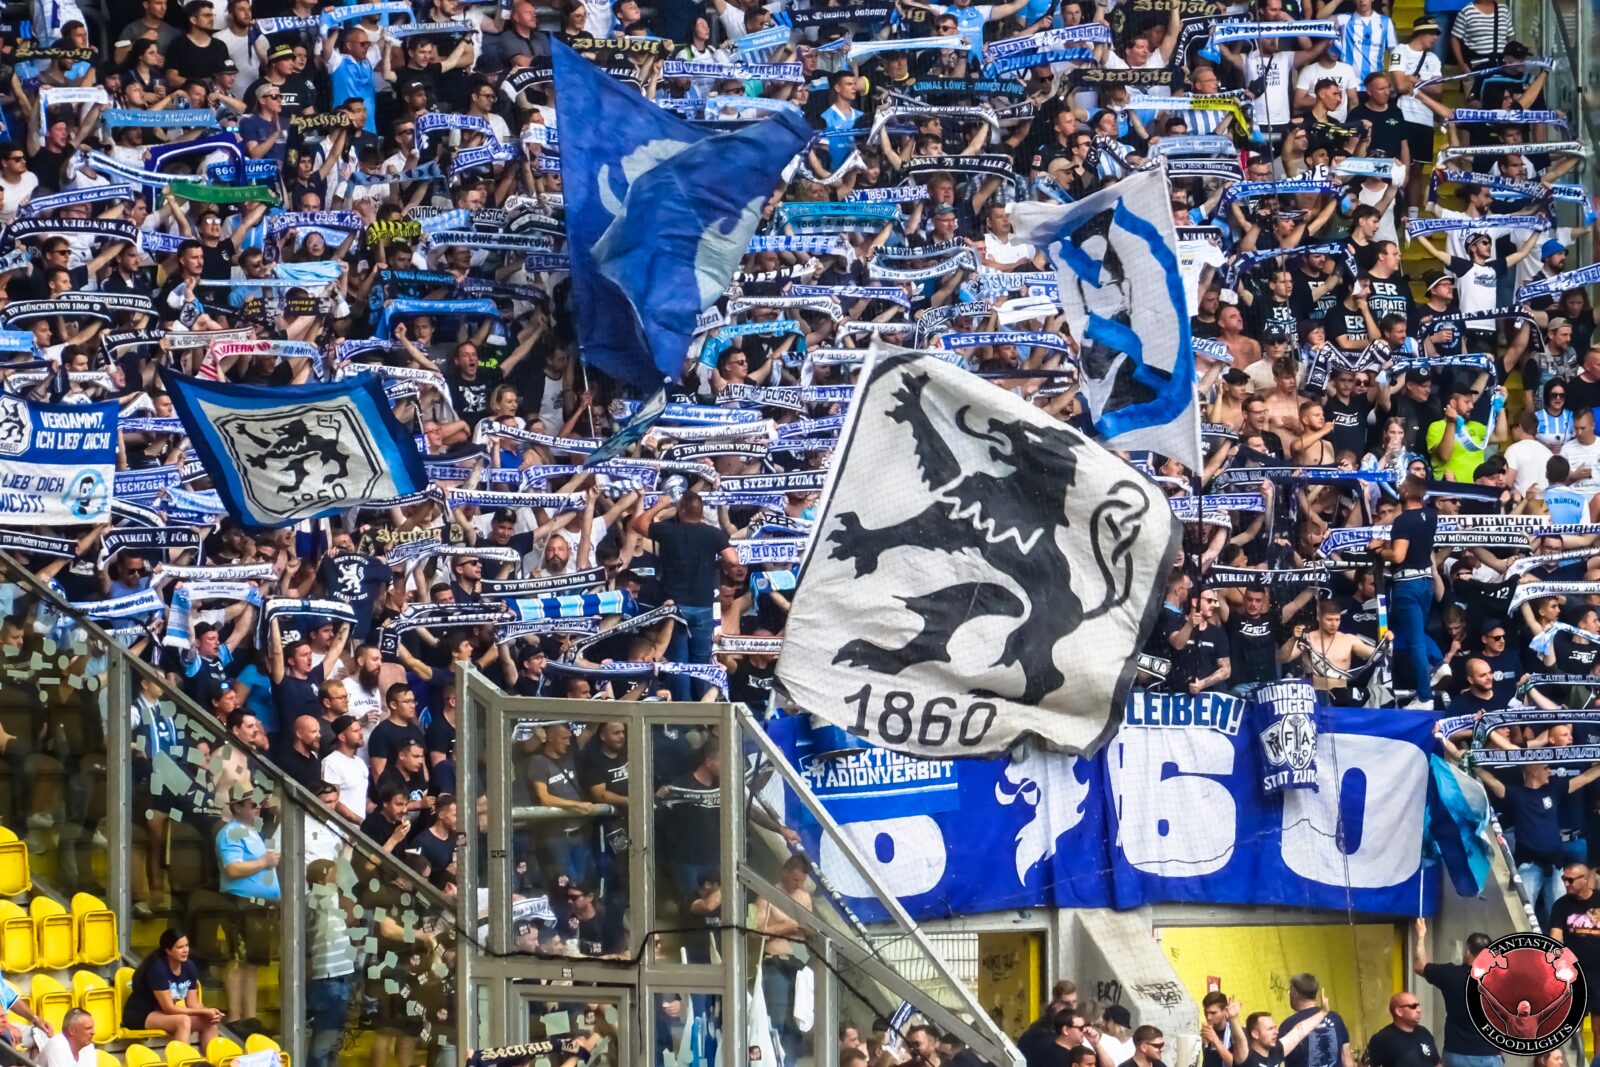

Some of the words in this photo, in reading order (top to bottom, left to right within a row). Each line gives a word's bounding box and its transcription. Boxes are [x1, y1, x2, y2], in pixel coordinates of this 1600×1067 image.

[1219, 25, 1239, 36] TSV
[607, 65, 629, 77] ALLE
[683, 62, 724, 73] VEREIN
[513, 73, 535, 85] MEIN
[1082, 69, 1173, 83] Sechzig
[913, 81, 943, 92] EINMAL
[944, 80, 967, 90] LÖWE
[1001, 83, 1025, 95] LÖWE
[1471, 172, 1495, 183] 1860
[1499, 175, 1549, 197] MÜNCHEN
[10, 219, 35, 233] 1860
[37, 219, 59, 229] VON
[63, 219, 117, 230] MÜNCHEN
[119, 221, 137, 236] TSV
[431, 232, 466, 244] EINMAL
[466, 233, 492, 244] LÖWE
[1373, 282, 1397, 295] ER
[6, 305, 18, 316] TSV
[18, 302, 54, 313] MÜNCHEN
[54, 302, 71, 311] VON
[71, 302, 90, 311] 1860
[118, 296, 134, 306] VON
[134, 297, 152, 310] 1860
[1369, 299, 1407, 313] HEIRATET
[1272, 306, 1292, 319] ER
[1484, 306, 1510, 318] VON
[1345, 314, 1365, 328] ER
[950, 334, 977, 346] DES
[979, 333, 993, 343] IS
[994, 331, 1065, 347] MÜNCHEN
[40, 411, 105, 431] VERDAMMT,
[36, 431, 56, 449] ICH
[57, 431, 83, 451] LIEB'
[500, 425, 554, 444] DEUTSCHER
[554, 436, 598, 449] MEISTER
[683, 445, 698, 455] TSV
[698, 443, 735, 454] MÜNCHEN
[735, 442, 751, 451] VON
[2, 475, 35, 491] LIEB'
[36, 477, 65, 491] DICH
[115, 479, 165, 492] SECHZGER
[743, 476, 786, 490] STEH'N
[787, 474, 815, 487] ZUM
[1553, 496, 1581, 508] MÜNCHEN
[13, 534, 38, 548] MÜNCHEN
[120, 533, 152, 544] VEREIN
[171, 531, 188, 543] FÜR
[1434, 534, 1448, 543] TSV
[1448, 533, 1489, 543] MÜNCHEN
[1489, 535, 1507, 543] VON
[504, 582, 517, 591] TSV
[517, 579, 552, 590] MÜNCHEN
[552, 578, 569, 587] VON
[569, 575, 586, 585] 1860
[1215, 572, 1256, 583] VEREIN
[1278, 571, 1300, 582] FÜR
[1301, 571, 1328, 583] ALLE
[843, 683, 998, 748] 1860
[1474, 751, 1507, 763] BLUE
[1508, 750, 1554, 762] BLOOD
[801, 760, 955, 789] STADIONVERBOT
